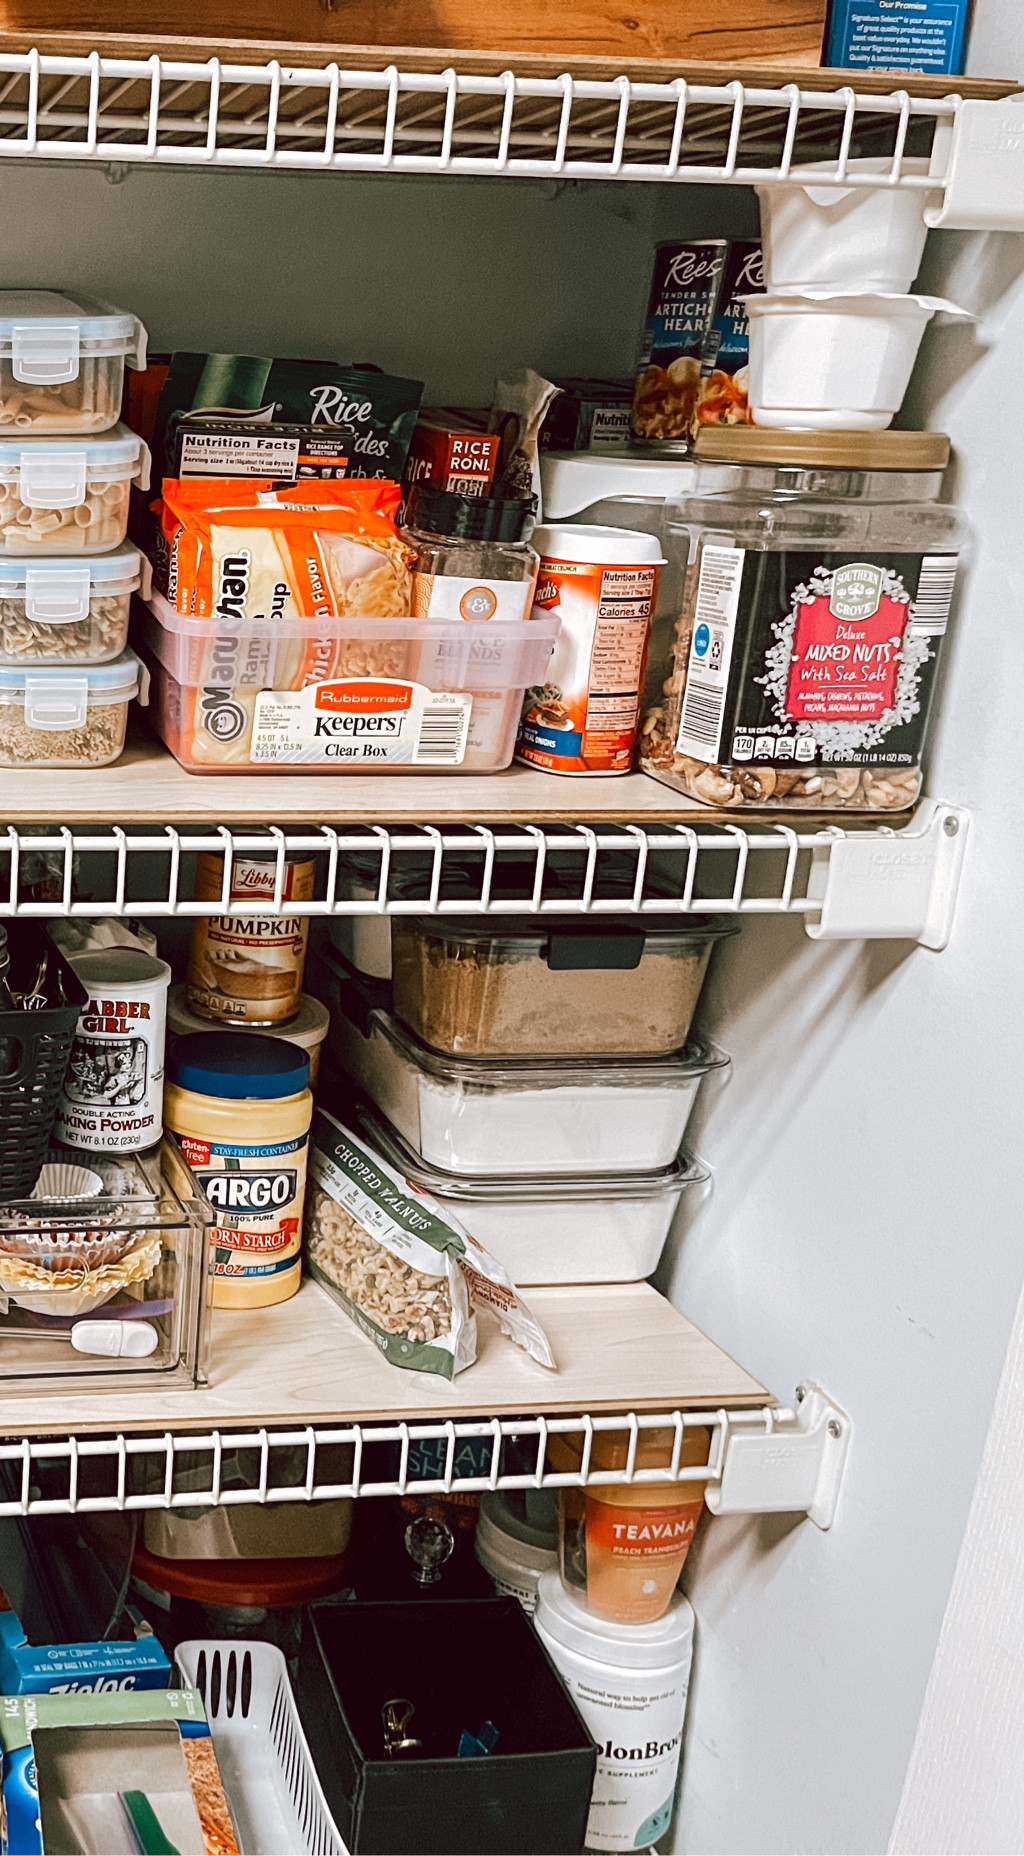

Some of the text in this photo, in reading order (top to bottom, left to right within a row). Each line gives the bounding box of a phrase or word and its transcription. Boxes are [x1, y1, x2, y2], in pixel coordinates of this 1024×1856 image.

[879, 1, 927, 11] Our Promise
[851, 14, 880, 23] Signature
[880, 26, 926, 35] quality products
[872, 45, 900, 54] Signature
[849, 54, 871, 63] Quality
[661, 291, 697, 299] TENDER
[309, 385, 373, 427] Rice
[185, 436, 297, 451] Nutrition Facts
[453, 440, 491, 456] RICE
[183, 456, 209, 464] Serving
[309, 449, 338, 457] DIRECTIONS
[305, 556, 327, 603] Flavor
[603, 571, 654, 582] Nutrition Facts
[836, 569, 879, 586] SOUTHERN
[603, 589, 620, 597] Serving
[599, 603, 650, 617] Calories 45
[836, 602, 871, 616] GROVE
[836, 624, 865, 640] Deluxe
[804, 644, 892, 663] MIXED NUTS
[801, 663, 887, 682] With Sea Salt
[320, 691, 408, 704] Rubbermaid
[828, 703, 860, 712] MACADAMIA
[861, 703, 876, 712] NUTS
[314, 715, 397, 738] Keepers
[535, 734, 556, 748] ONIONS
[736, 739, 752, 749] 170
[325, 743, 388, 758] Clear Box
[208, 916, 302, 936] PUMPKIN
[220, 936, 245, 944] NATURAL
[72, 1107, 136, 1118] DOUBLE ACTING
[59, 1114, 154, 1132] AKING POWDER
[65, 1131, 141, 1147] NET WT 8.1 OZ (230g)
[181, 1138, 210, 1152] gluten-
[185, 1149, 205, 1163] free
[214, 1141, 299, 1157] STAY-FRESH CONTAINER
[334, 1144, 382, 1190] CHOPPED
[206, 1175, 290, 1207] ARGO
[230, 1214, 275, 1222] 100% PURE
[243, 1230, 285, 1248] STARCH
[613, 1519, 695, 1541] TEAVANA
[613, 1545, 642, 1555] PEACH
[577, 1682, 648, 1703] Natural way help
[4, 1698, 18, 1718] 145
[608, 1768, 658, 1778] SUPPLEMENT
